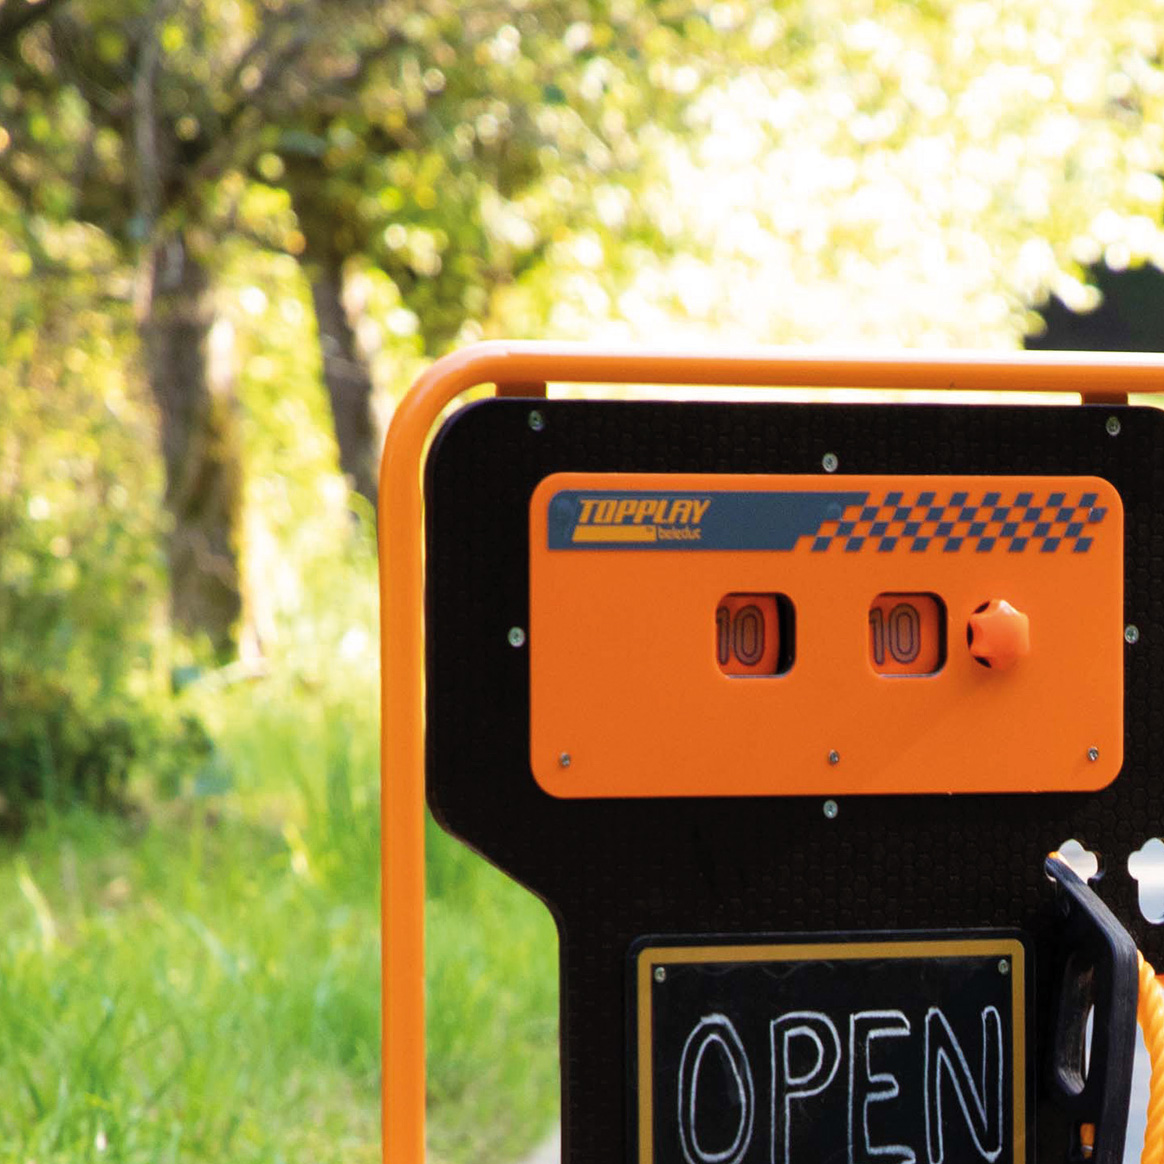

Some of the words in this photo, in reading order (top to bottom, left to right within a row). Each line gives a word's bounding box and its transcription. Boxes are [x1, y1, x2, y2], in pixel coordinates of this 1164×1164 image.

[579, 499, 711, 524] TOPPLAY
[716, 604, 765, 666] 10
[869, 602, 921, 666] 10
